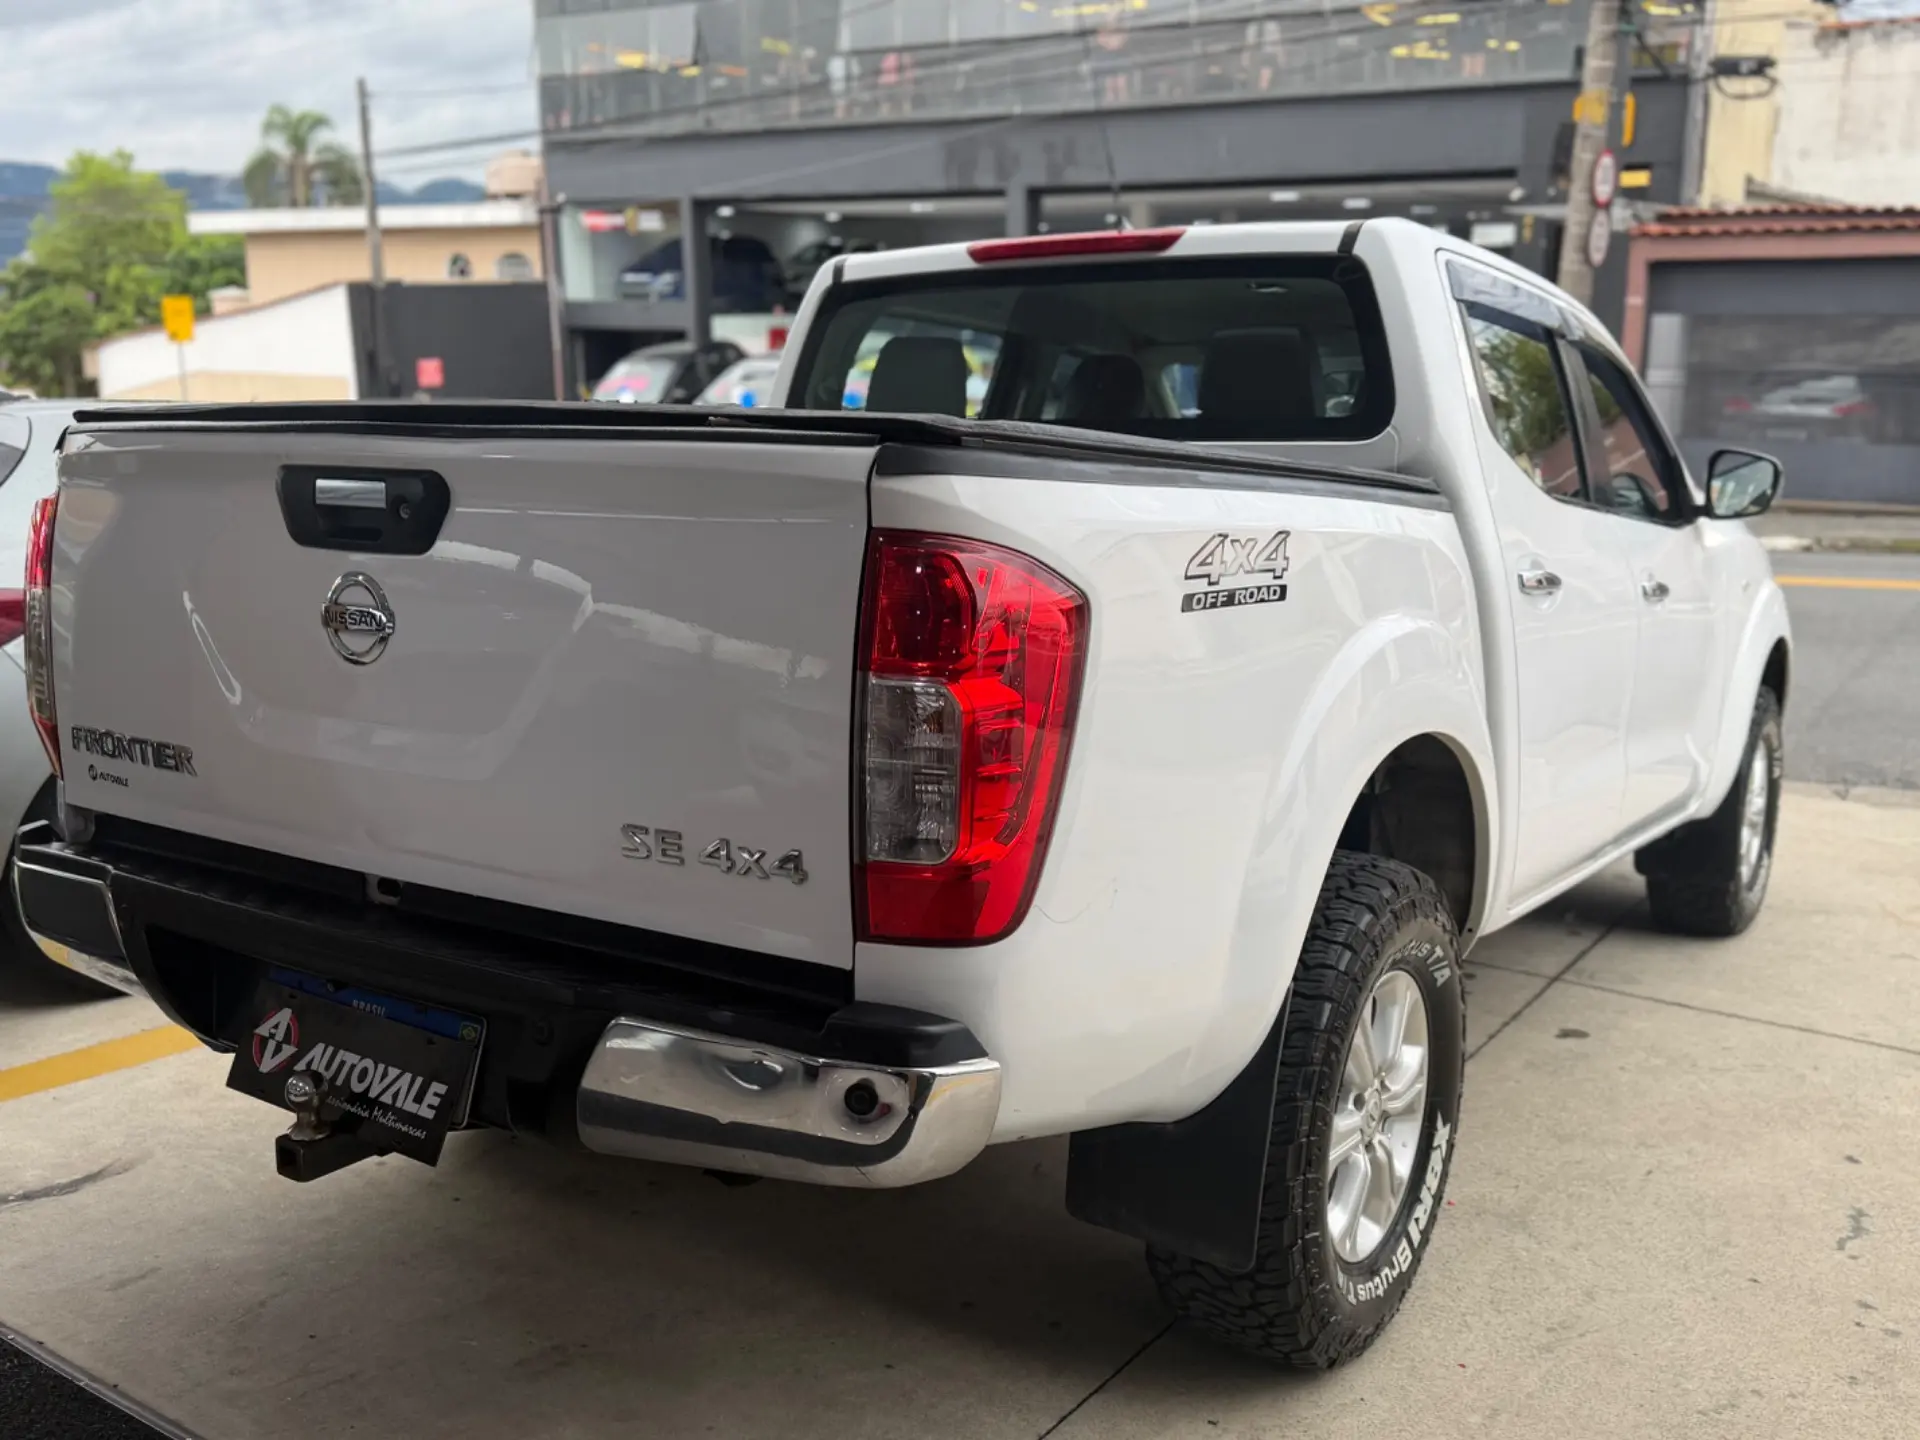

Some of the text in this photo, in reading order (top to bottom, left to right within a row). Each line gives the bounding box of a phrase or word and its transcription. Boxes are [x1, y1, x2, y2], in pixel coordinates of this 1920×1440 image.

[325, 608, 381, 627] NISSAN
[1192, 586, 1280, 610] OFF ROAD
[71, 724, 198, 777] FRONTIER
[620, 823, 685, 866] SE
[294, 1042, 449, 1121] AUTOVALE
[1407, 1110, 1451, 1249] XBRI
[1357, 1237, 1413, 1303] Brutus
